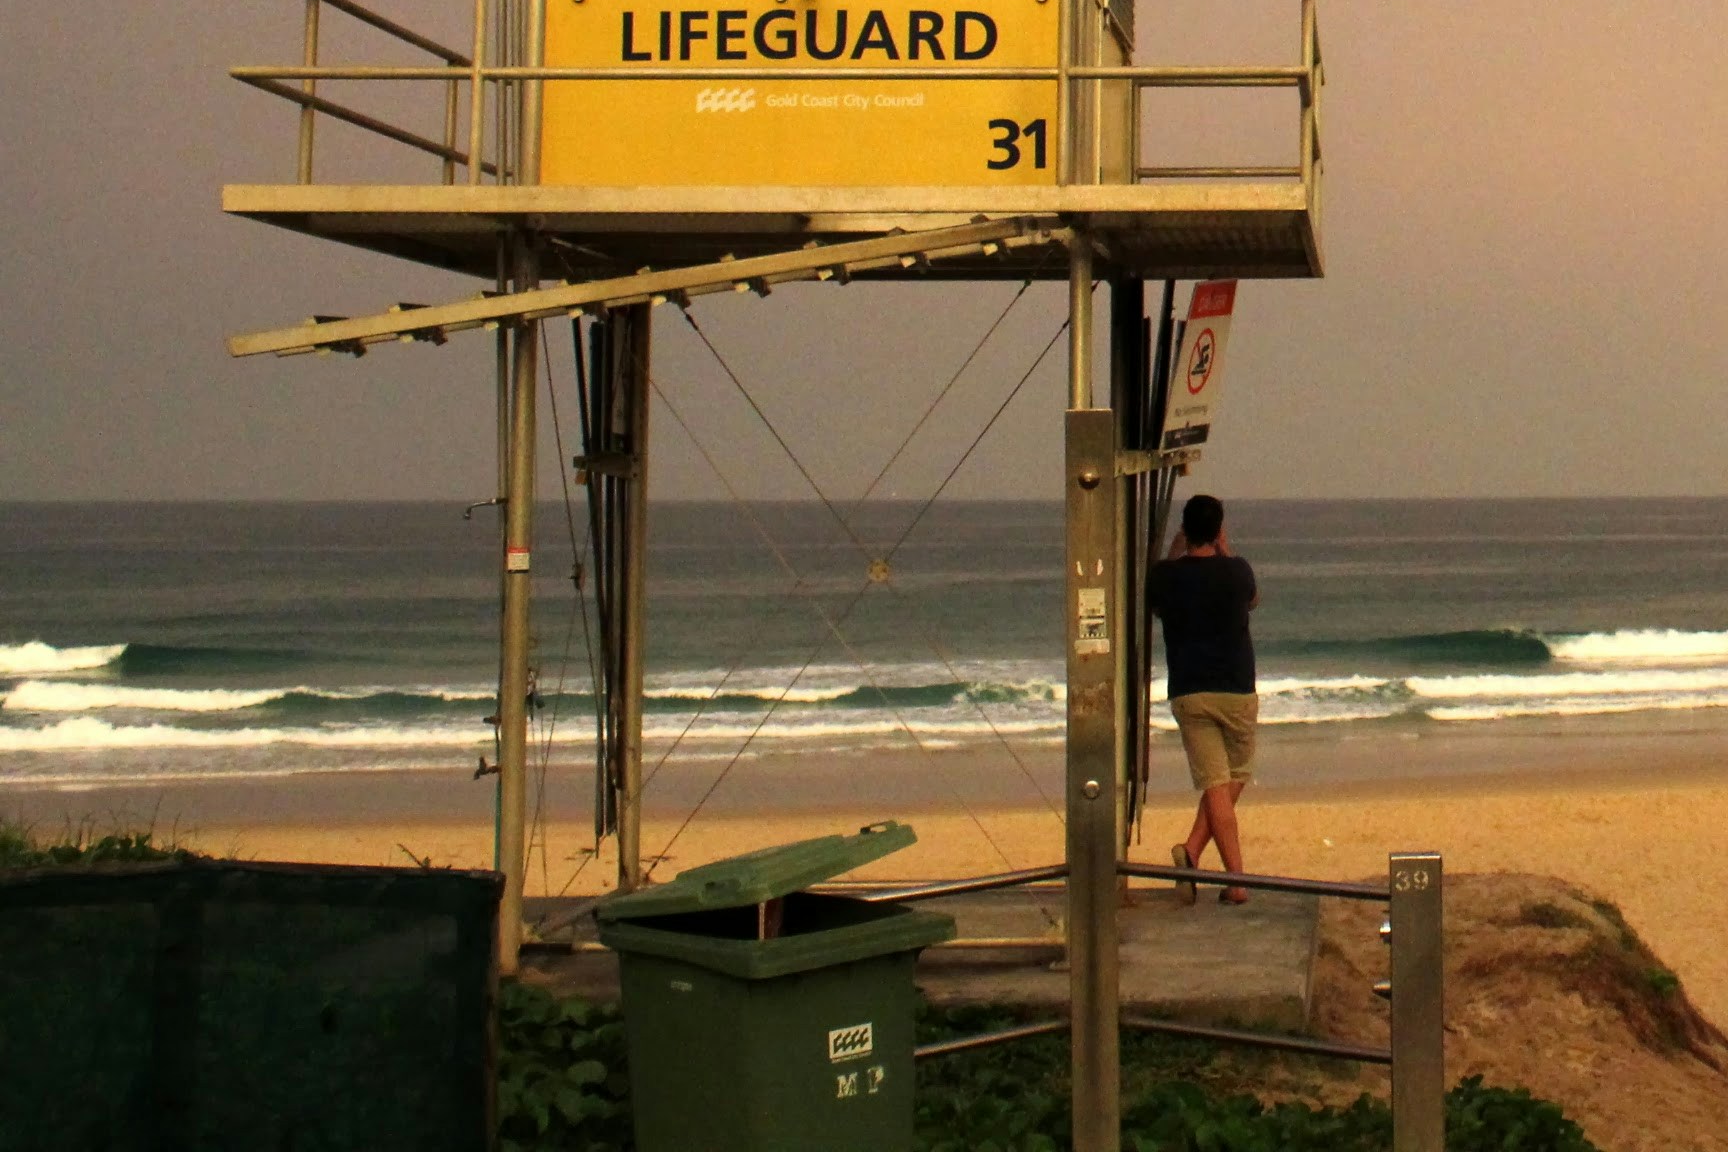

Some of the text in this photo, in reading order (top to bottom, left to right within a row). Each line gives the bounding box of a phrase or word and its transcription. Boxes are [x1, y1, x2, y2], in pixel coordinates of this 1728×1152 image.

[621, 9, 998, 61] LIFEGUARD
[766, 93, 924, 110] Gold Coast City Council
[986, 119, 1047, 170] 31
[1395, 870, 1429, 891] 39
